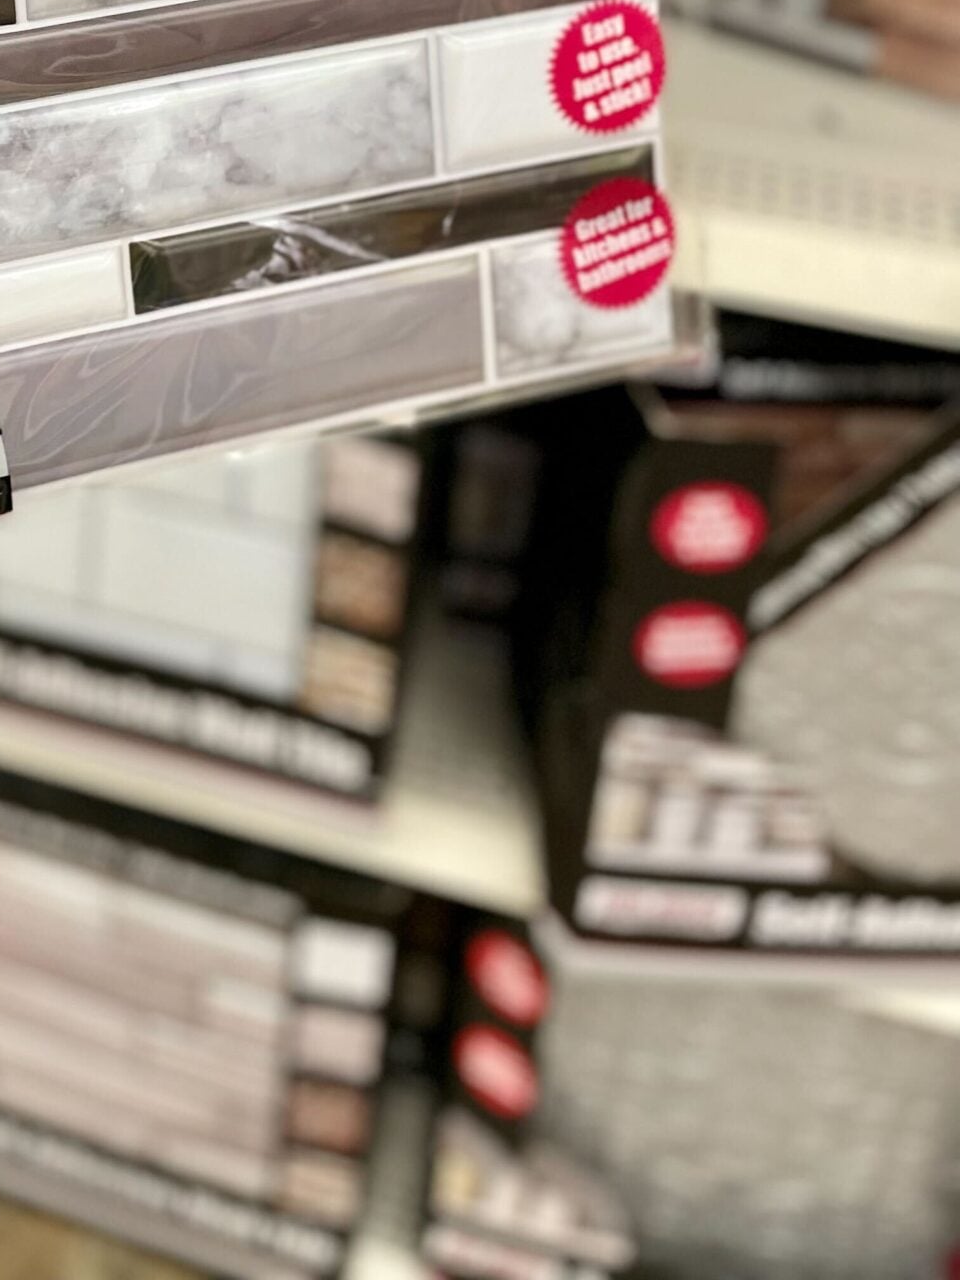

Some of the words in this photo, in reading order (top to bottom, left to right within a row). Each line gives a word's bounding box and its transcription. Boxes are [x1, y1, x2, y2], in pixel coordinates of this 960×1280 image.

[581, 14, 625, 46] Easy
[577, 50, 600, 73] to
[610, 51, 653, 87] peel
[574, 206, 626, 242] Great
[625, 196, 653, 223] for
[572, 223, 652, 269] kitchens
